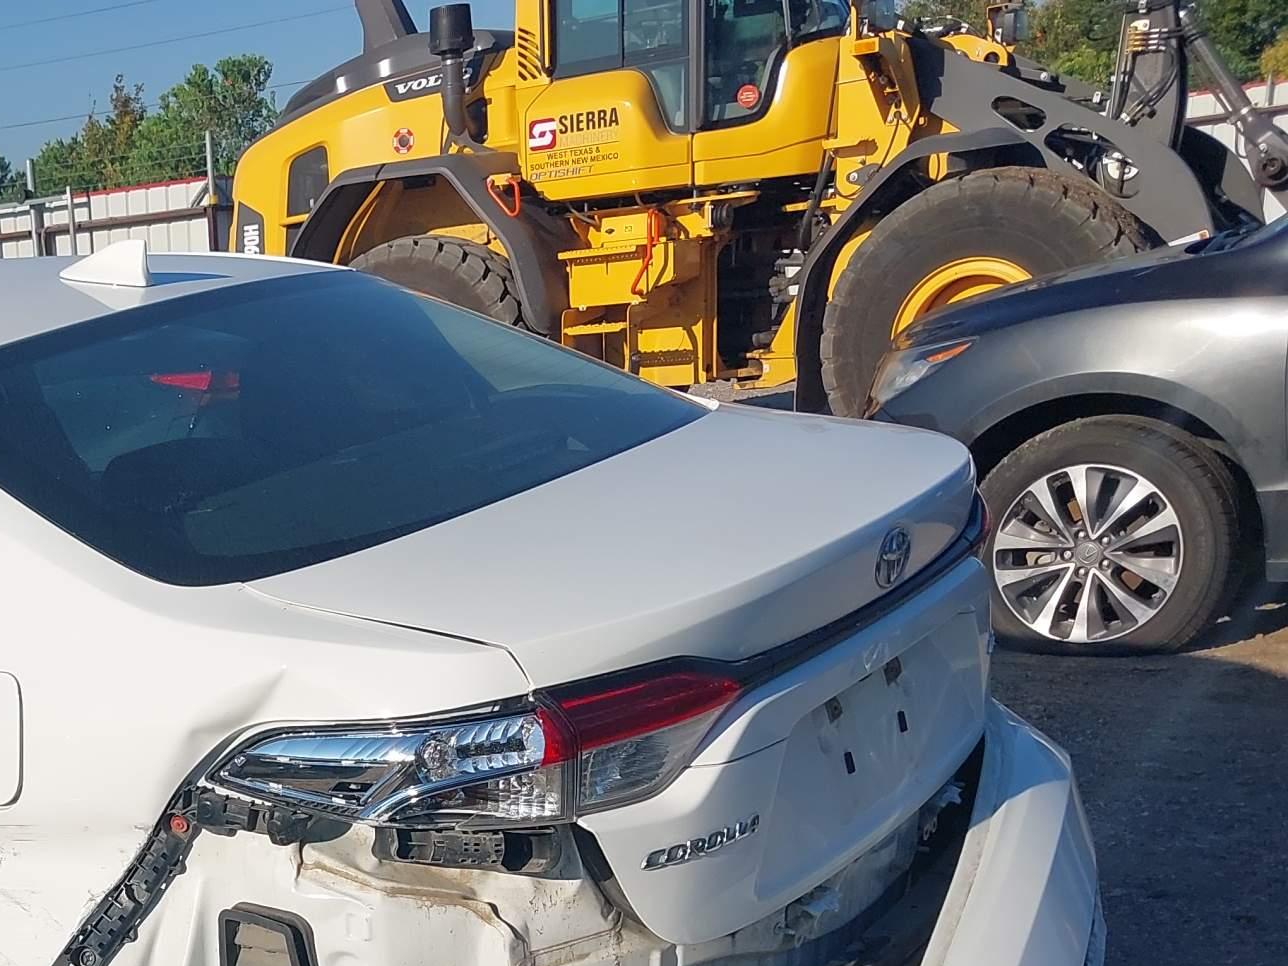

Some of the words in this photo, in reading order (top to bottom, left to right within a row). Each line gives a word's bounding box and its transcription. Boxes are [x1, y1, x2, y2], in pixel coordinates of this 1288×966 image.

[559, 107, 619, 134] SIERRA
[530, 159, 569, 171] SOUTHERN
[572, 156, 588, 165] NEW
[592, 152, 619, 163] MEXICO
[547, 149, 569, 160] WEST
[569, 147, 593, 157] TEXAS
[530, 165, 593, 181] OPTISHIFT
[640, 814, 760, 871] COROLLA
